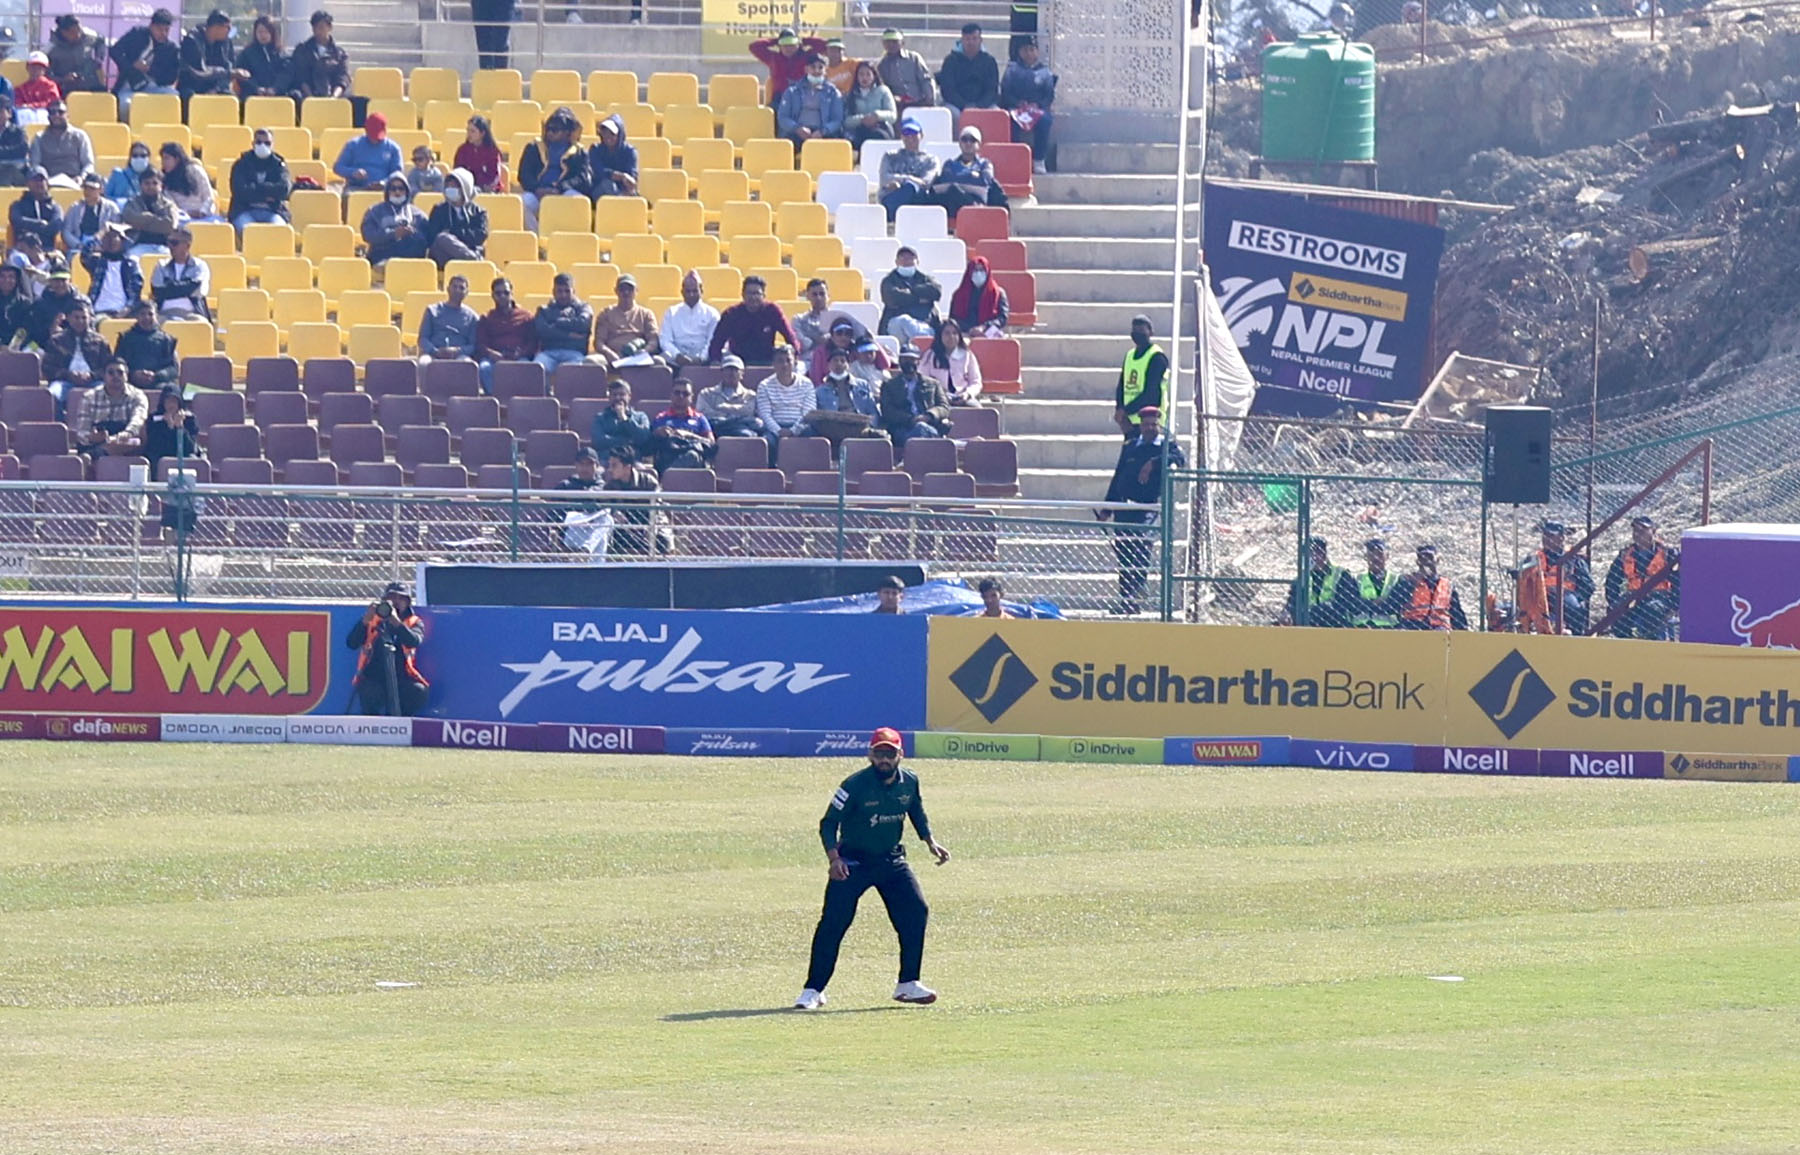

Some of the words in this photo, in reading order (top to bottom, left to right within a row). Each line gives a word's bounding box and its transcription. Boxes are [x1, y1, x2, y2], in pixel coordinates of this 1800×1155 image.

[1238, 224, 1401, 275] RESTROOMS
[1271, 303, 1397, 369] NPL
[1270, 349, 1304, 364] NEPAL
[1305, 356, 1351, 372] PREMIER
[1352, 364, 1393, 380] LEAGUE
[1298, 369, 1351, 395] Ncell
[552, 622, 668, 644] BAJAJ
[147, 628, 310, 697] WAI
[499, 626, 851, 719] pulsar
[442, 721, 507, 747] Ncell
[568, 727, 633, 750] Ncell
[814, 735, 872, 754] pulsa
[964, 741, 1009, 754] inDrive
[1089, 742, 1136, 756] inDrive
[1196, 745, 1226, 758] WAI
[1228, 744, 1258, 757] WAI
[1315, 745, 1390, 769] vivo
[1443, 748, 1509, 770] Ncell
[1569, 753, 1634, 776] Ncell
